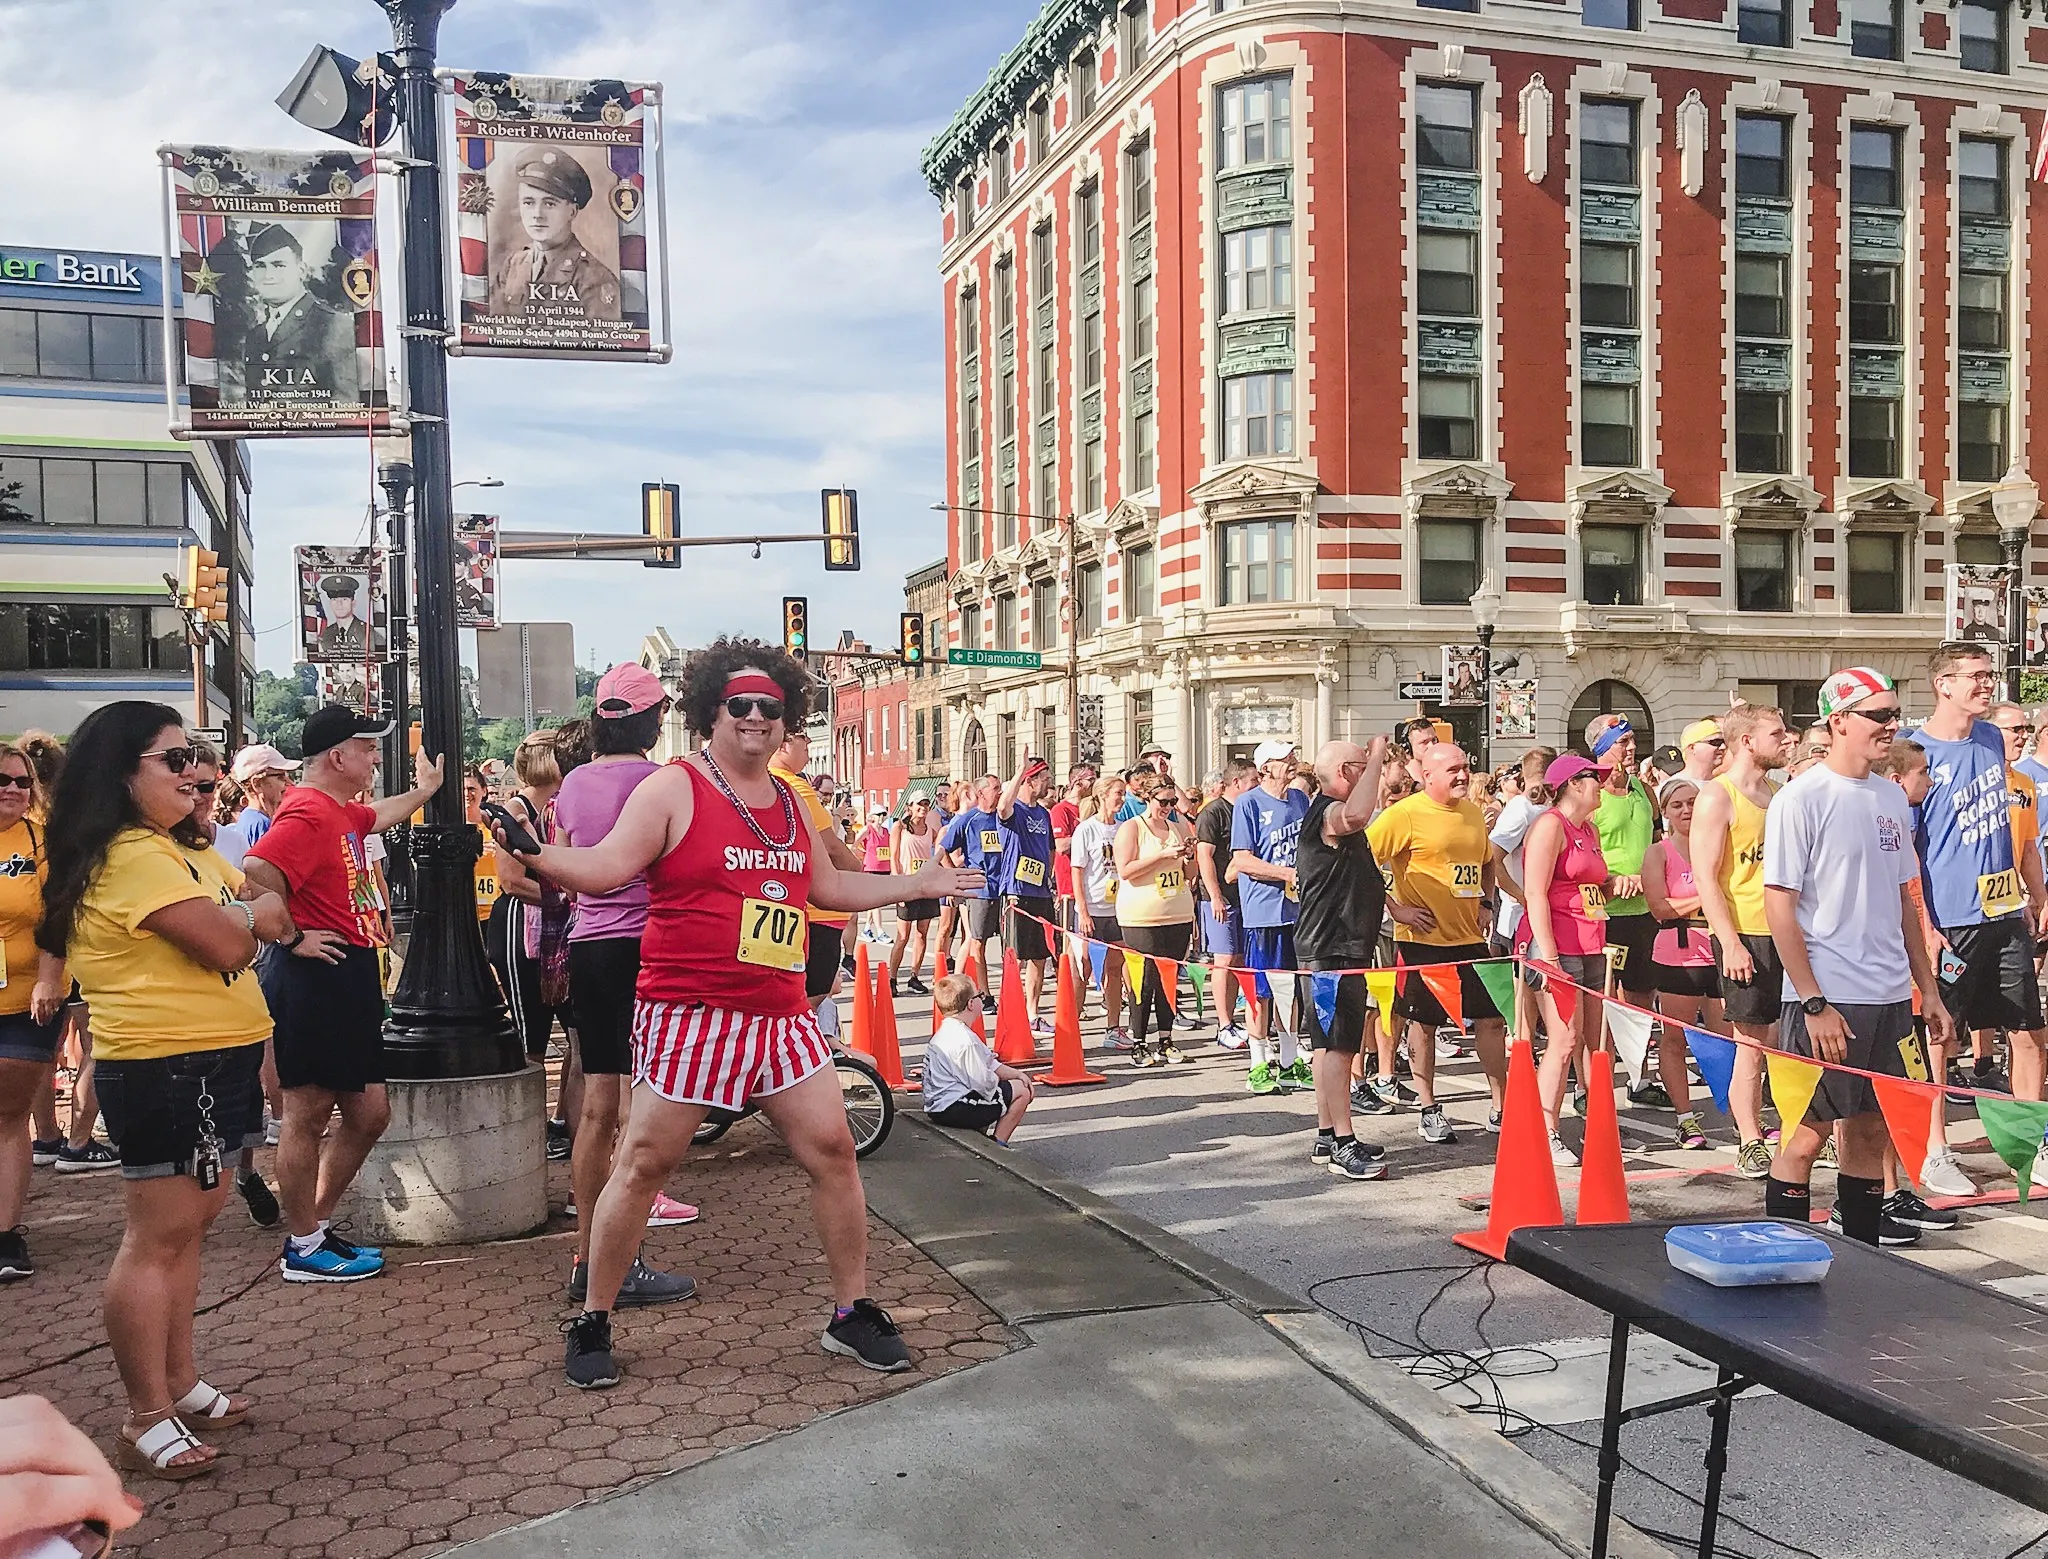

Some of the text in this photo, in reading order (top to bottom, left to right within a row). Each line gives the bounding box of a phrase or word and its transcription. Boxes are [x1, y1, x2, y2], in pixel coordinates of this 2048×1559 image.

[492, 80, 506, 94] of
[458, 119, 471, 128] Sgt
[477, 122, 632, 142] Robert F. Widenhofer
[189, 197, 203, 207] Sgt
[211, 197, 342, 214] William Bennetti
[0, 253, 141, 286] er Bank
[528, 283, 580, 302] KIA
[525, 305, 585, 316] 13 April 1944
[475, 314, 504, 324] World
[505, 316, 527, 325] War
[546, 317, 592, 329] Budapest,
[593, 319, 634, 331] Hungary
[469, 325, 641, 342] 719th Bomb Sqdn, 449th Bomb Group
[488, 338, 622, 350] United States Army Air Force
[264, 368, 317, 386] KIA
[250, 389, 331, 399] 11 December 1944
[217, 401, 248, 410] World
[249, 401, 267, 409] War
[285, 401, 329, 412] European
[329, 401, 366, 410] Theater
[206, 412, 229, 420] 141st
[229, 412, 267, 421] Infantry
[268, 412, 285, 420] Co.
[302, 412, 320, 420] 36th
[321, 412, 358, 421] Infantry
[248, 421, 281, 429] United
[311, 421, 337, 429] Army
[335, 635, 358, 643] KIA
[967, 652, 1038, 665] E Diamond St
[1952, 763, 2004, 812] BUTLER
[1957, 790, 1999, 831] ROAD
[723, 845, 806, 875] SWEATIN'
[912, 859, 928, 870] 37
[1022, 858, 1042, 876] 353
[1159, 871, 1180, 888] 217
[1454, 864, 1479, 885] 235
[477, 878, 494, 895] 46
[1986, 873, 2012, 901] 221
[752, 904, 799, 946] 707
